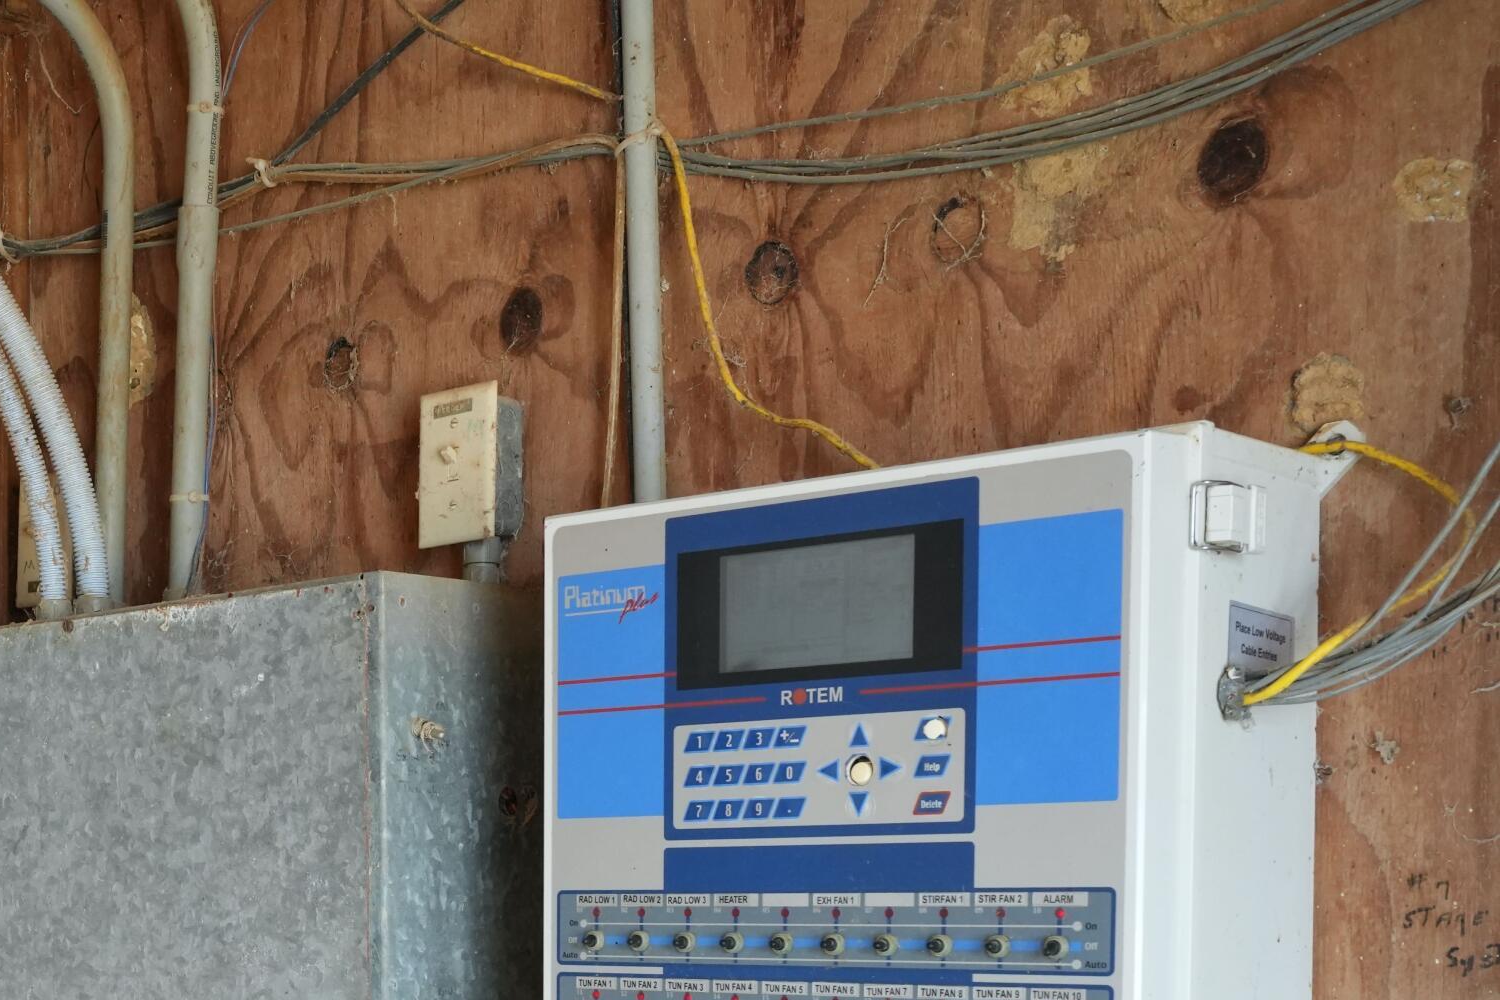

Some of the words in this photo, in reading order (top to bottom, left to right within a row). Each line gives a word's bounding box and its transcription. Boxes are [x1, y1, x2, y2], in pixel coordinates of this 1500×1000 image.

[564, 585, 646, 609] Platinum
[1236, 621, 1250, 634] Place
[1252, 625, 1264, 637] Low
[1266, 628, 1286, 645] Voltage
[1241, 643, 1256, 656] Cable
[1258, 648, 1277, 662] Entries
[780, 686, 843, 706] ROTEM
[696, 735, 702, 748] 1
[726, 734, 733, 748] 2
[756, 732, 762, 746] 3
[924, 762, 940, 773] Help
[696, 770, 702, 783] 4
[726, 769, 732, 782] 5
[756, 767, 762, 781] 6
[786, 766, 793, 780] 0
[921, 799, 942, 809] Delete
[696, 805, 702, 818] 7
[725, 803, 732, 817] 8
[756, 802, 762, 816] 9
[579, 895, 593, 904] RAD
[594, 896, 610, 904] LOW
[623, 895, 637, 903] RAD
[639, 895, 655, 904] LOW
[656, 896, 661, 904] 2
[719, 896, 748, 904] HEATER
[817, 896, 833, 905] EXH
[835, 896, 849, 905] FAN
[922, 895, 958, 904] STIRFAN
[979, 895, 997, 904] STIR
[999, 895, 1015, 904] FAN
[1017, 895, 1022, 904] 2
[1043, 895, 1074, 904] ALARM
[1085, 922, 1098, 931] On
[1084, 942, 1098, 951] Off
[562, 951, 579, 959] Auto
[1084, 960, 1107, 969] Auto
[579, 979, 592, 987] TUN
[594, 979, 607, 987] FAN
[623, 980, 637, 988] TUN
[638, 980, 652, 988] FAN
[653, 981, 658, 989] 2
[668, 982, 682, 990] TUN
[683, 983, 698, 991] FAN
[699, 983, 704, 991] 3
[716, 983, 730, 991] TUN
[731, 983, 746, 991] FAN
[746, 983, 752, 991] 4
[765, 984, 780, 992] TUN
[781, 984, 796, 993] FAN
[798, 985, 804, 994] 5
[815, 985, 830, 993] TUN
[832, 985, 847, 994] FAN
[849, 986, 855, 995] 6
[867, 987, 883, 996] TUN
[884, 987, 900, 996] FAN
[902, 987, 907, 996] 7
[921, 988, 938, 997] TUN
[940, 988, 956, 997] FAN
[958, 990, 963, 998] 8
[976, 989, 993, 998] TUN
[995, 990, 1012, 998] FAN
[1014, 990, 1020, 998] 9
[1032, 990, 1050, 999] TUN
[1051, 991, 1069, 1000] FAN
[1071, 992, 1082, 1000] 10
